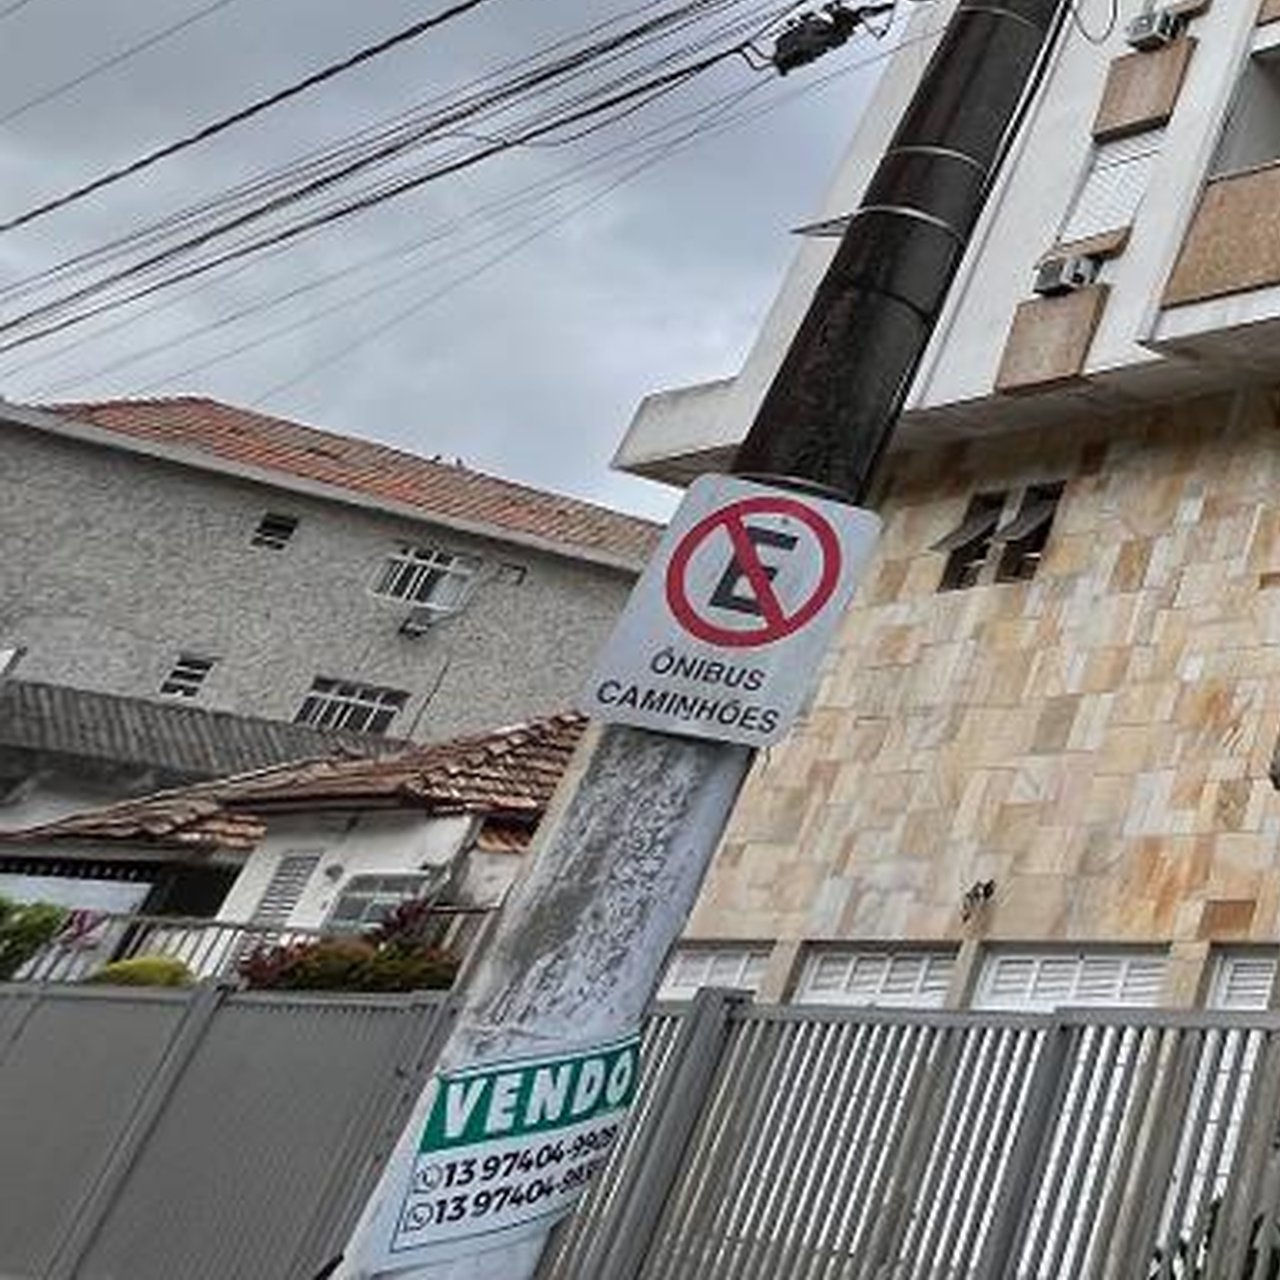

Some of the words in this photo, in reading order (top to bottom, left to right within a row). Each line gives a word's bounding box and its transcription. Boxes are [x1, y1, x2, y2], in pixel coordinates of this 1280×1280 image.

[650, 646, 765, 691] ÔNIBUS
[597, 680, 779, 734] CAMINHÕES
[443, 1049, 634, 1139] VENDO
[444, 1158, 477, 1188] 13
[436, 1193, 468, 1223] 13
